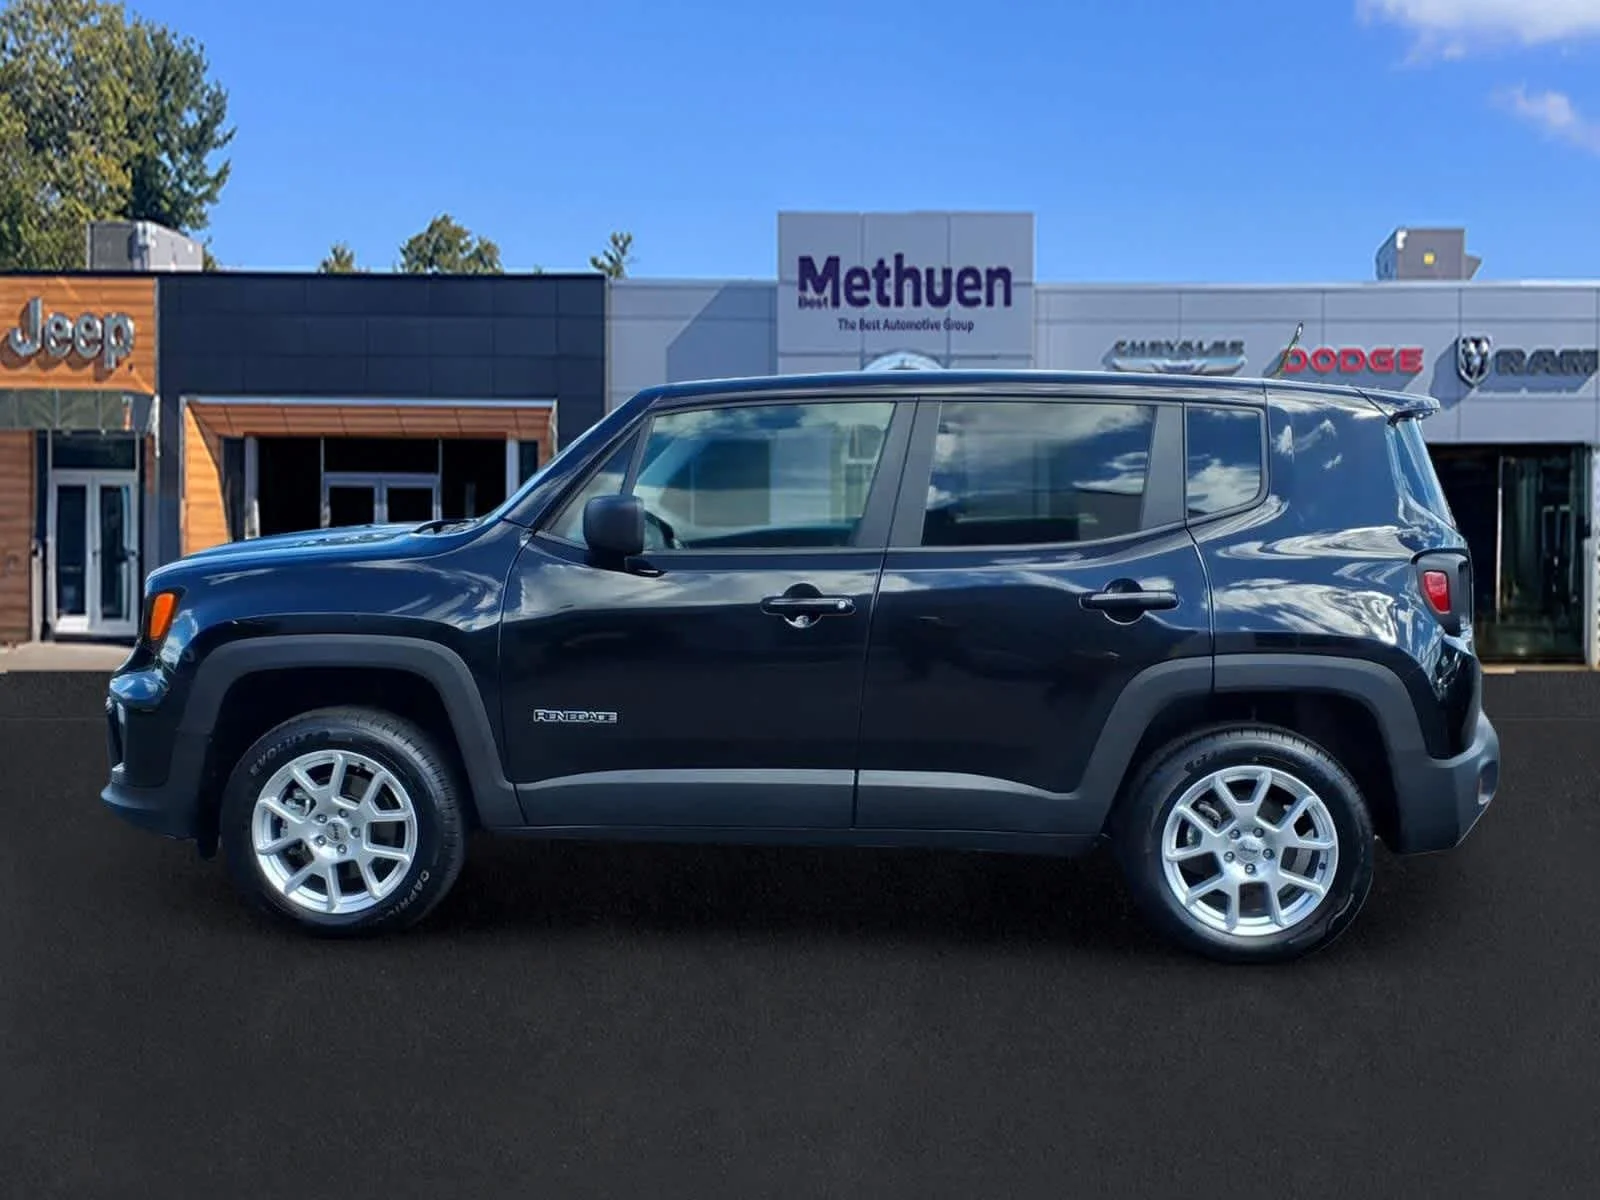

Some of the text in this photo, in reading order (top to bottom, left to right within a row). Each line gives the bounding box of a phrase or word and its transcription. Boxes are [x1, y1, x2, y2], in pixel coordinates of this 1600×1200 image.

[798, 253, 1012, 308] Methuen
[8, 296, 136, 369] Jeep
[838, 318, 974, 333] The Best Automotive Group
[1283, 347, 1424, 374] DODGE
[1495, 348, 1598, 376] RAM
[533, 709, 618, 723] RENEGADE
